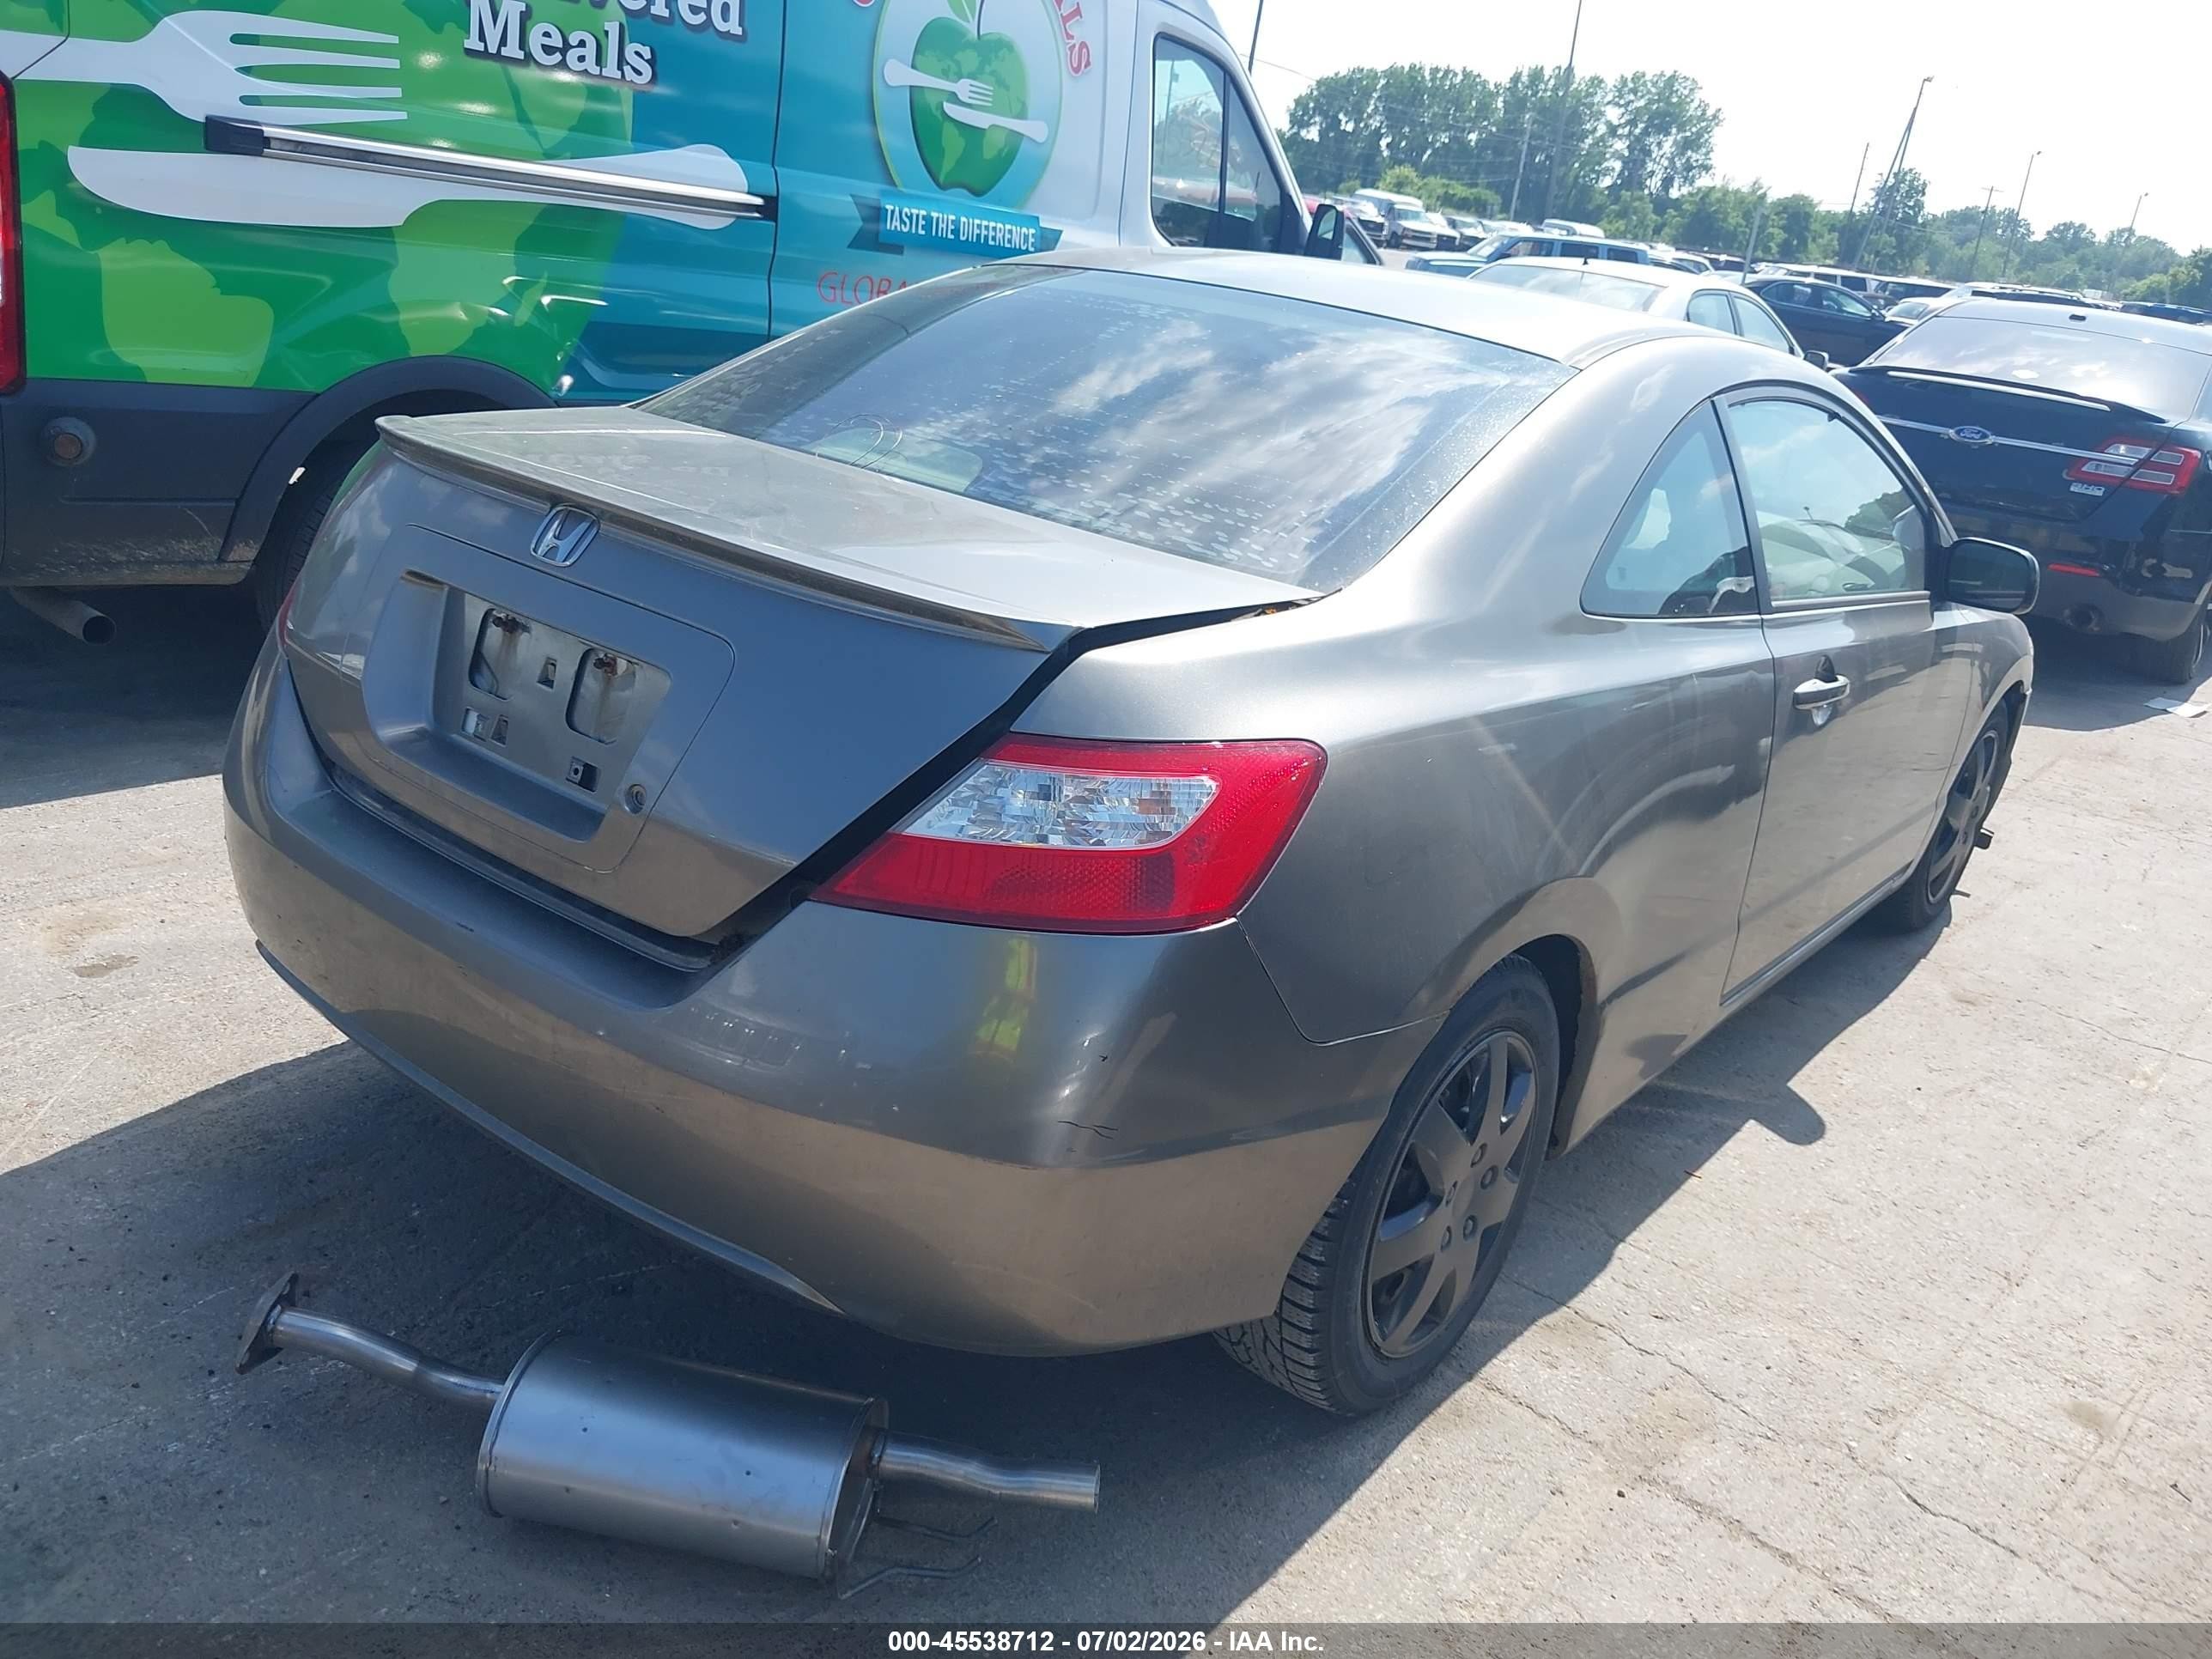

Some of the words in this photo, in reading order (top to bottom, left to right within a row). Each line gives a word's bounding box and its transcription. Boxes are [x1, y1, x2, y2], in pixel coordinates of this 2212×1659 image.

[464, 0, 653, 84] Meals
[884, 204, 927, 235] TASTE
[930, 211, 957, 240] THE
[959, 216, 1036, 252] DIFFERENCE
